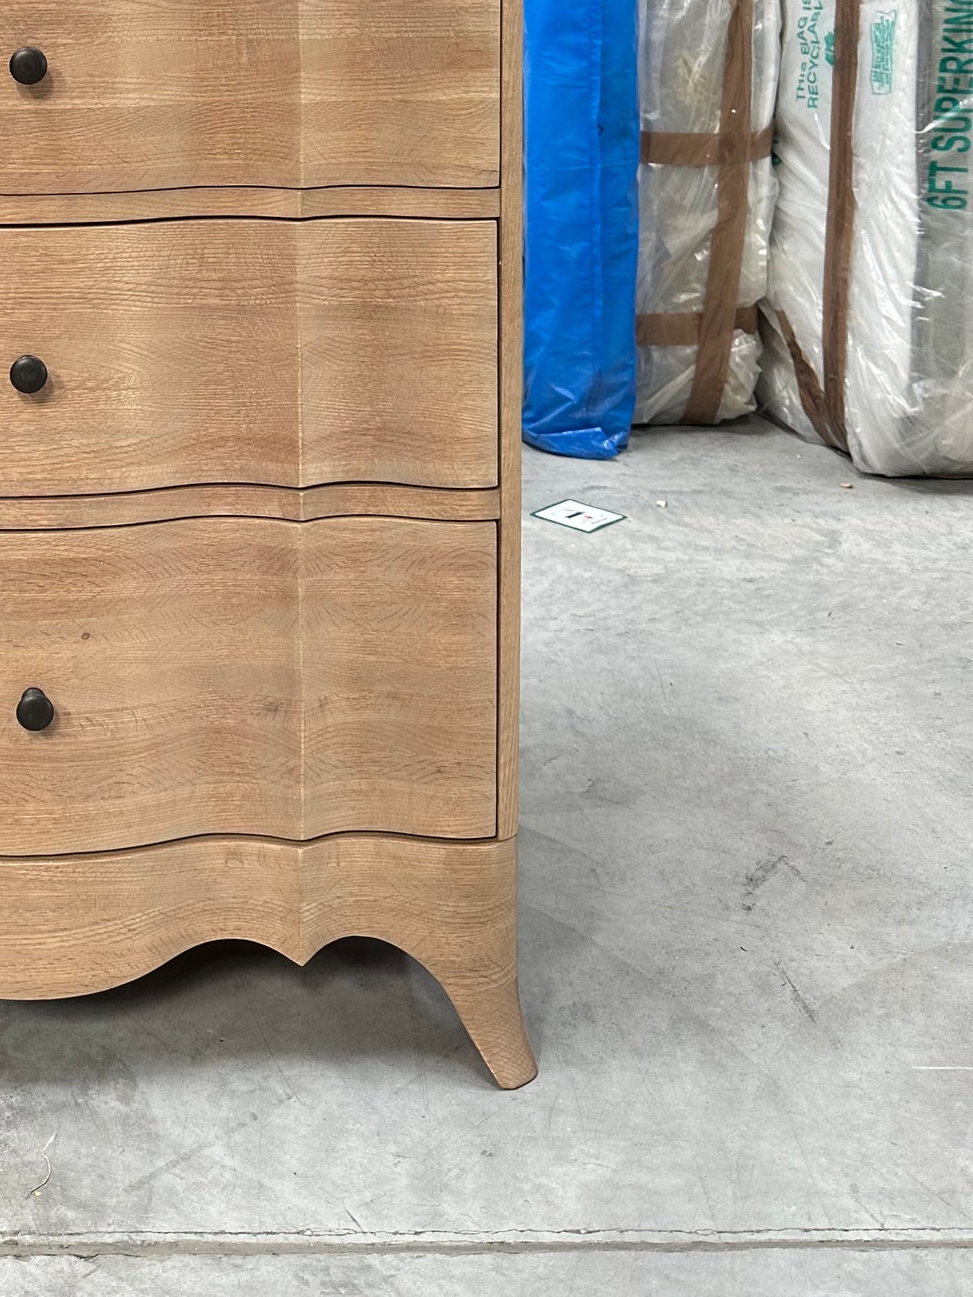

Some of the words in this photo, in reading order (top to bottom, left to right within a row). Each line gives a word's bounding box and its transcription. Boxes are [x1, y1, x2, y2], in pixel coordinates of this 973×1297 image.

[796, 17, 810, 55] BAG
[796, 62, 807, 103] THIS
[927, 160, 969, 210] 6FT
